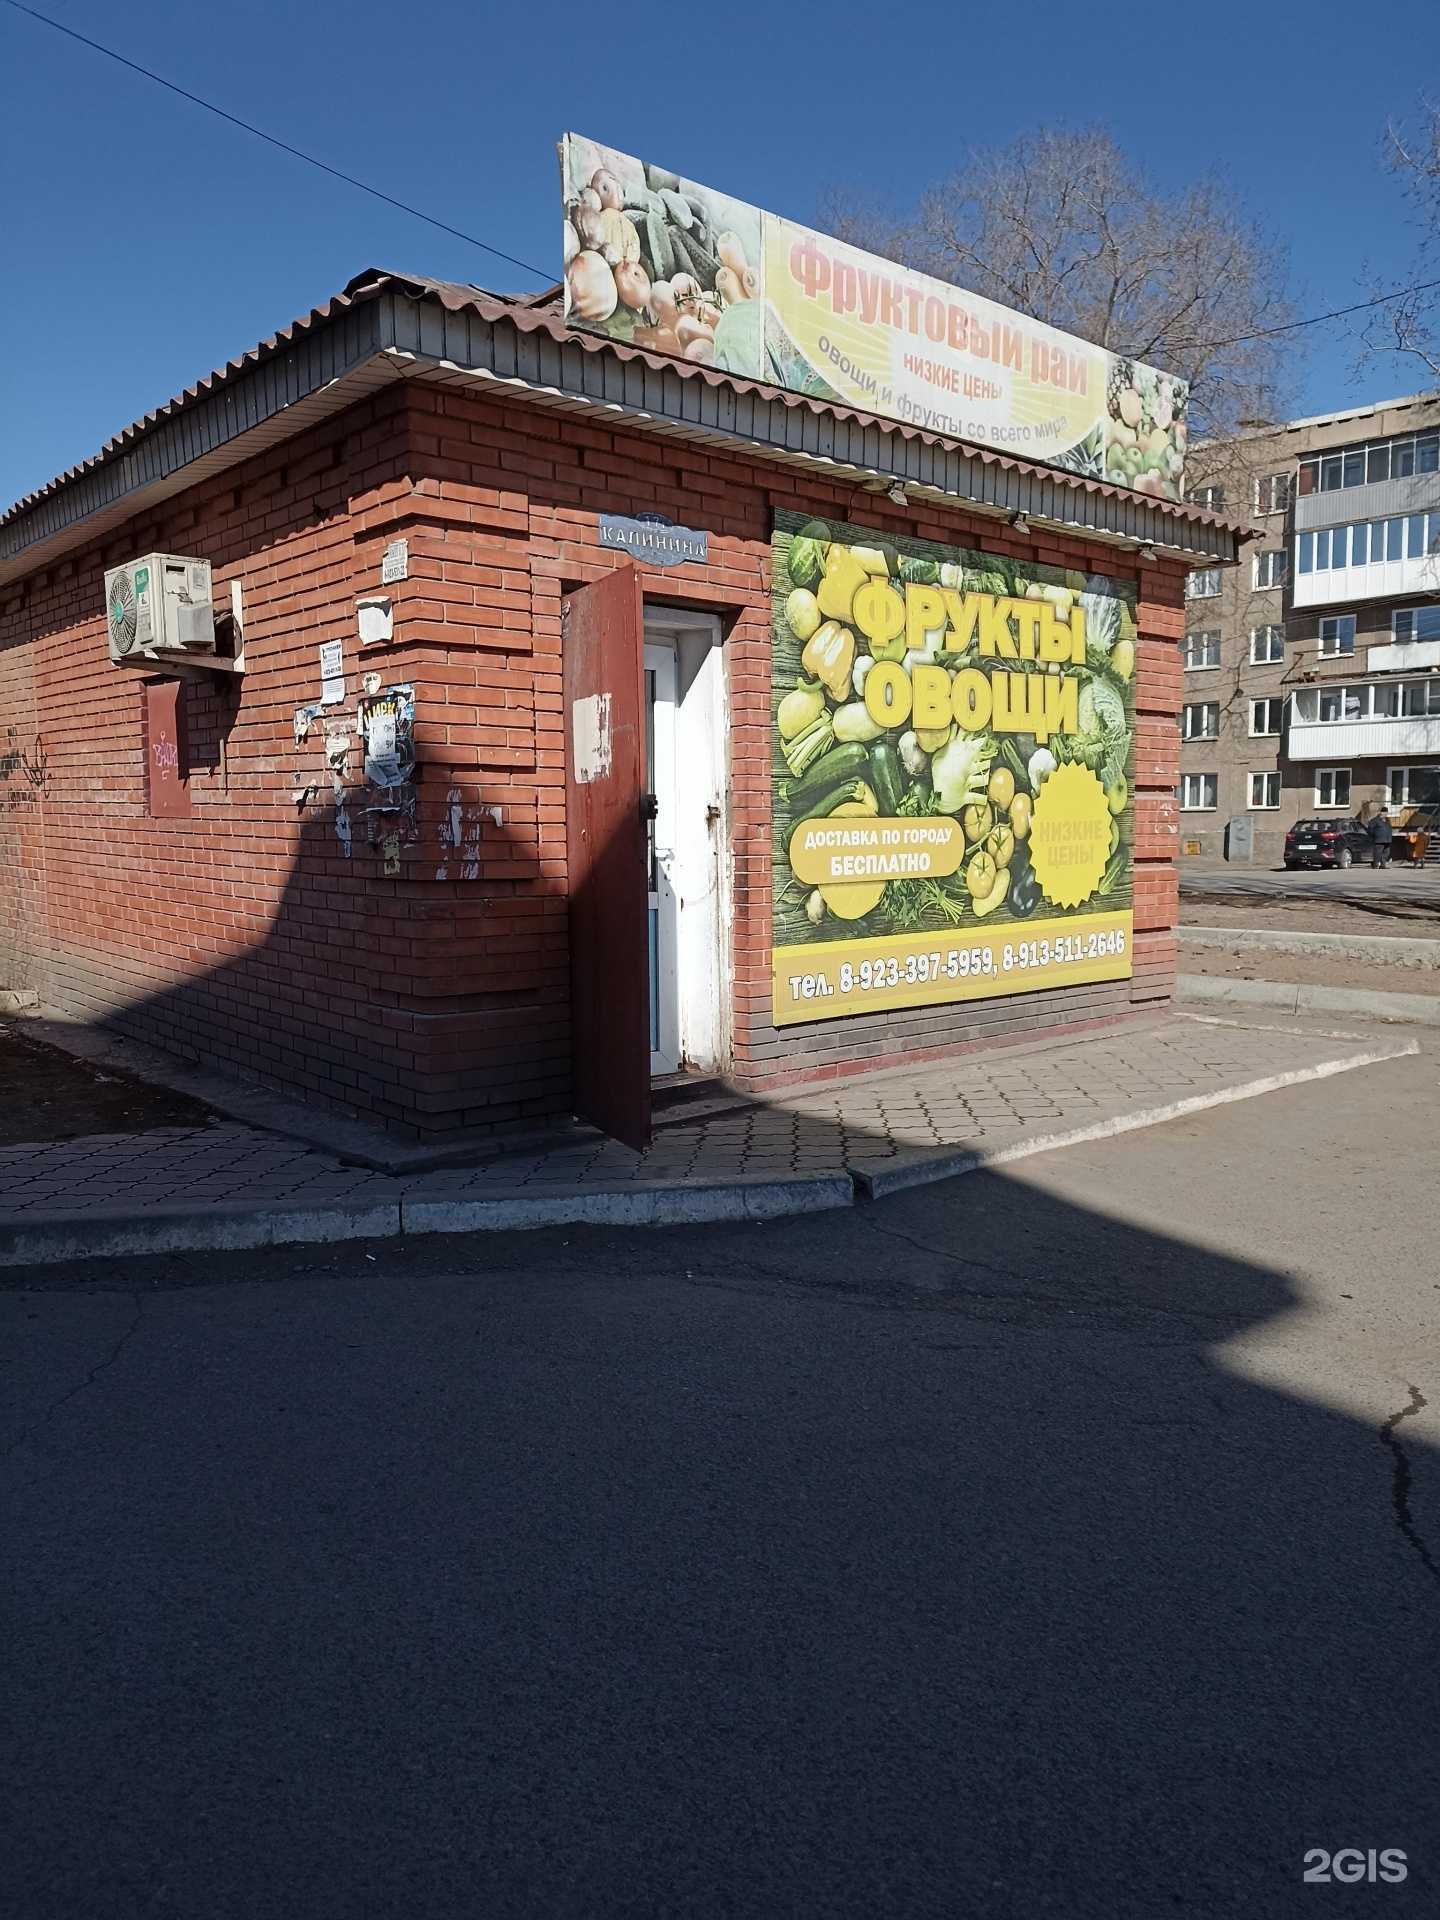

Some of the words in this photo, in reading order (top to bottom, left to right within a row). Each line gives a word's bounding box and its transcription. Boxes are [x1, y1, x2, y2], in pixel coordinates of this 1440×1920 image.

[881, 387, 893, 404] и
[897, 392, 962, 434] фрукты
[967, 421, 986, 439] со
[990, 424, 1031, 442] всего
[602, 525, 705, 557] КАЛИНИНА
[852, 574, 1087, 665] ФРУКТЫ
[864, 660, 1079, 744] ОВОЩИ
[804, 829, 878, 850] ДОСТАВКА
[881, 828, 901, 845] ПО
[903, 827, 953, 845] ГОРОДУ
[1040, 819, 1103, 842] НИЗКИЕ
[830, 852, 931, 876] БЕСПЛАТНО
[789, 971, 834, 1000] тел.
[839, 946, 998, 993] 8-923-397-5959,
[1002, 929, 1125, 971] 8-913-511-2646
